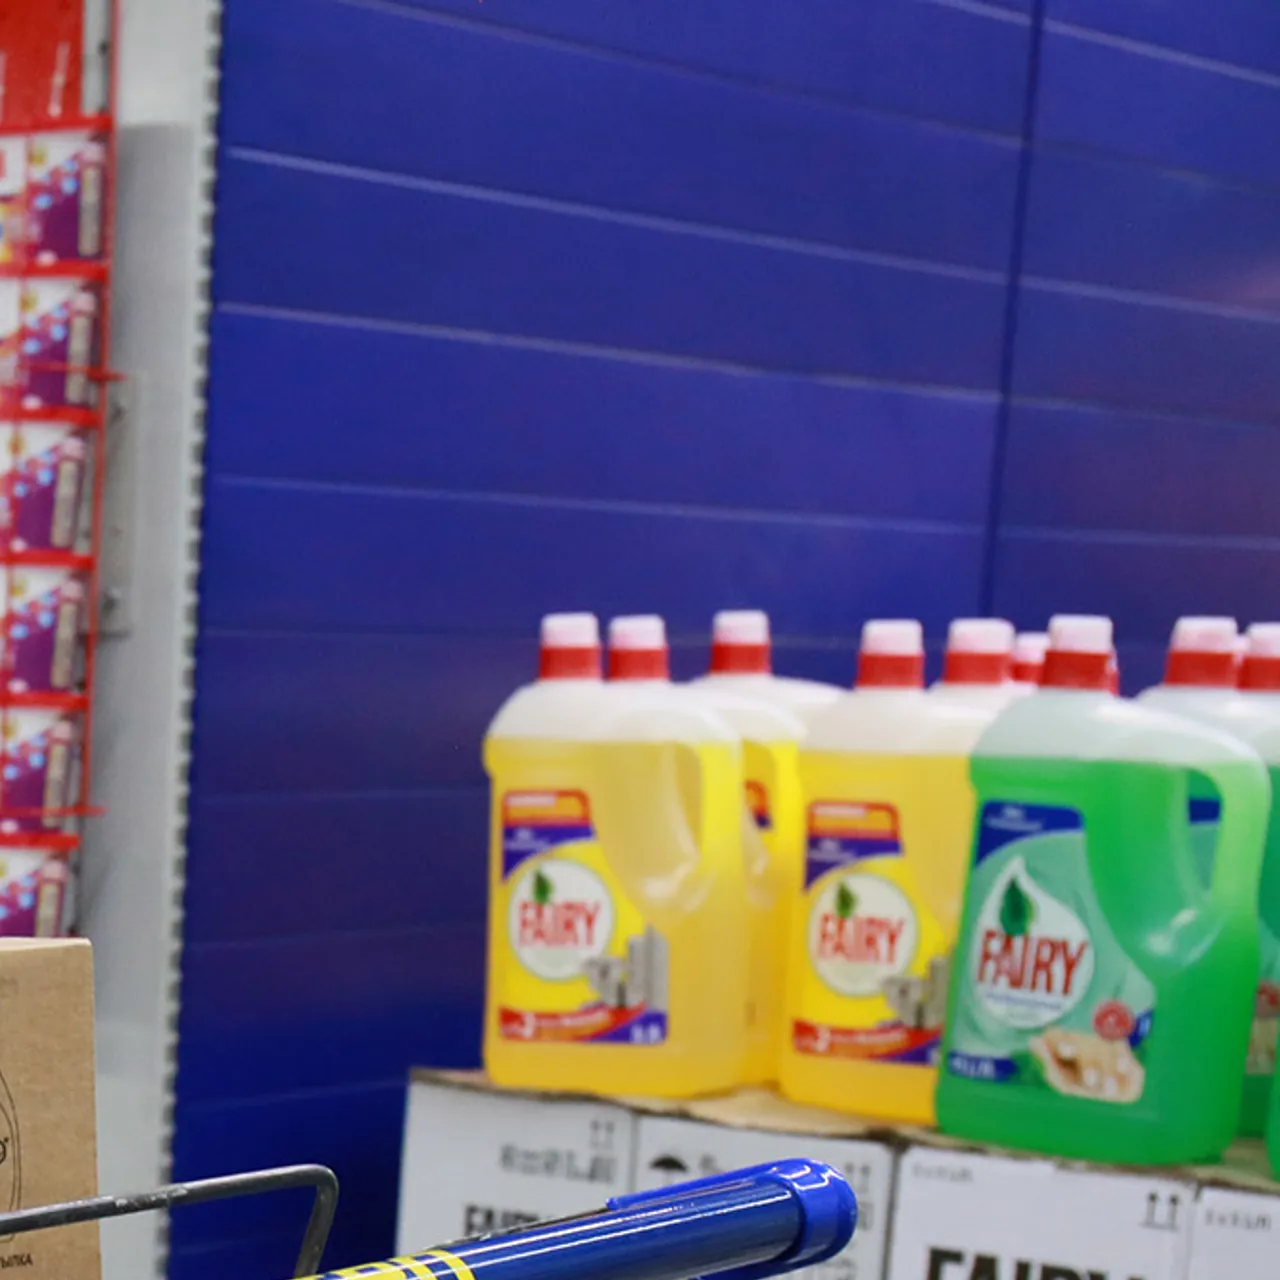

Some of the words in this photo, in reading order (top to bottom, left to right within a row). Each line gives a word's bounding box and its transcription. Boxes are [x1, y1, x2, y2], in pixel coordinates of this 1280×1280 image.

[518, 899, 601, 948] FAIRY
[819, 913, 907, 966] FAIRY
[978, 929, 1088, 997] FAIRY
